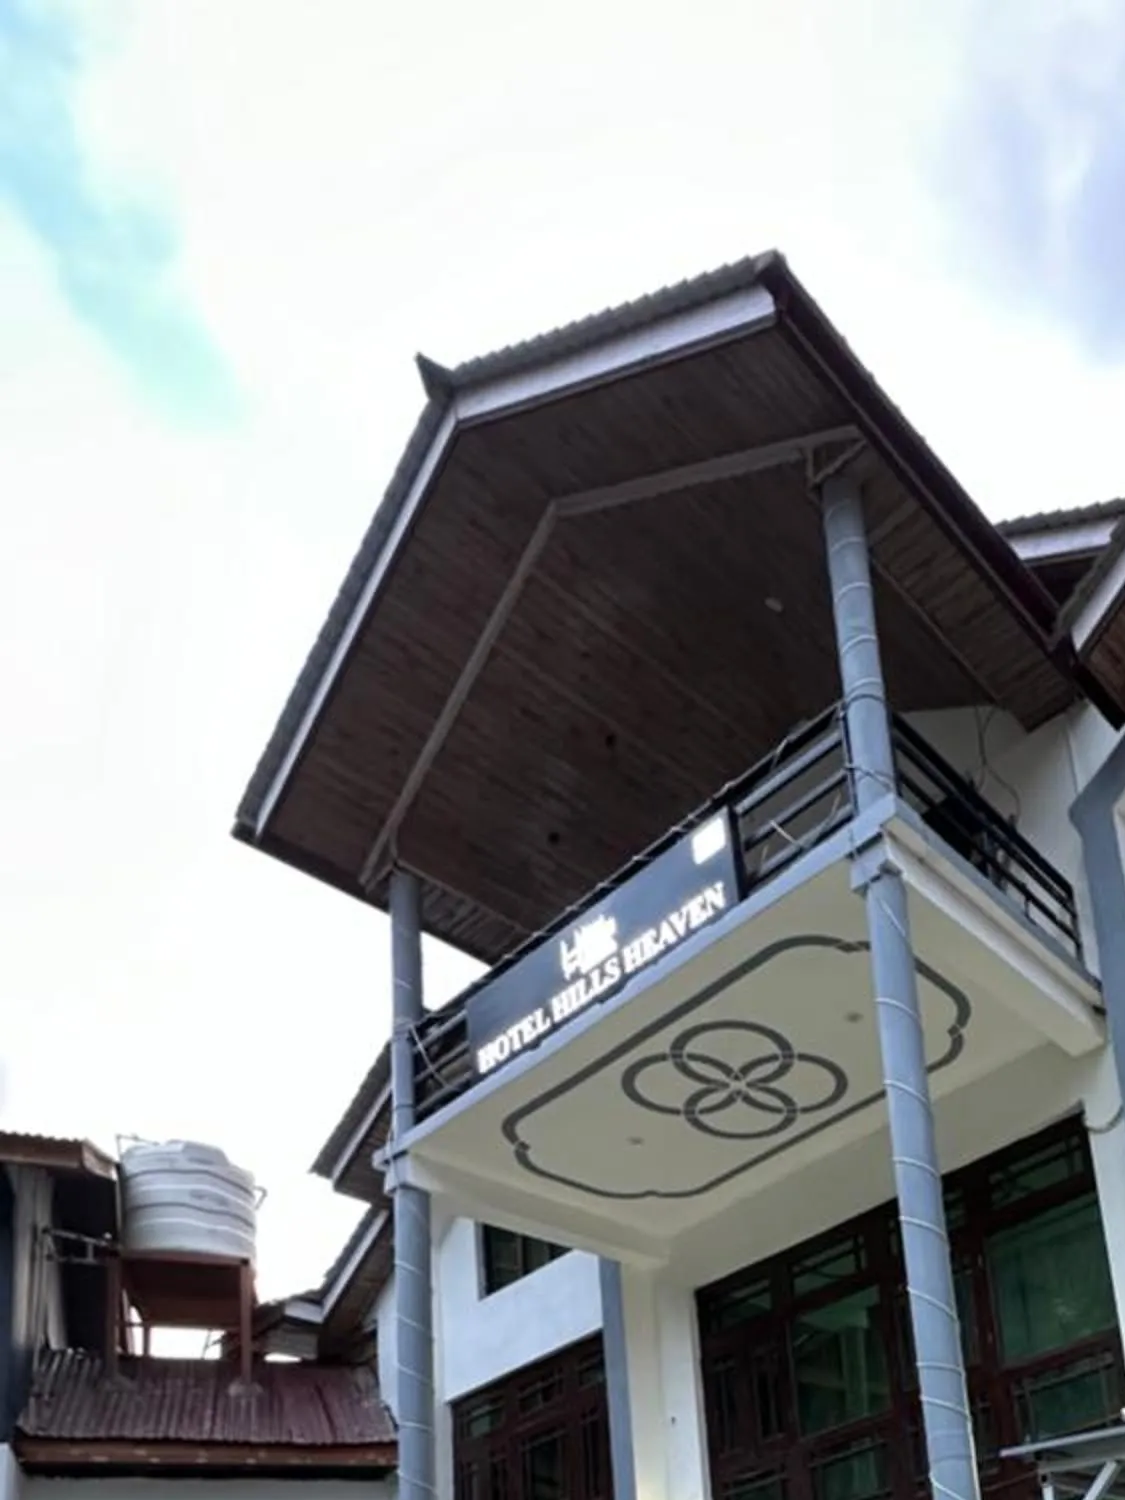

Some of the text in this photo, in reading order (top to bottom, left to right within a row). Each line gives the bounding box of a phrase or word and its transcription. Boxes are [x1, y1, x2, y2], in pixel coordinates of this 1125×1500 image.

[477, 881, 726, 1074] HOTEL HILLS HEAVEN
